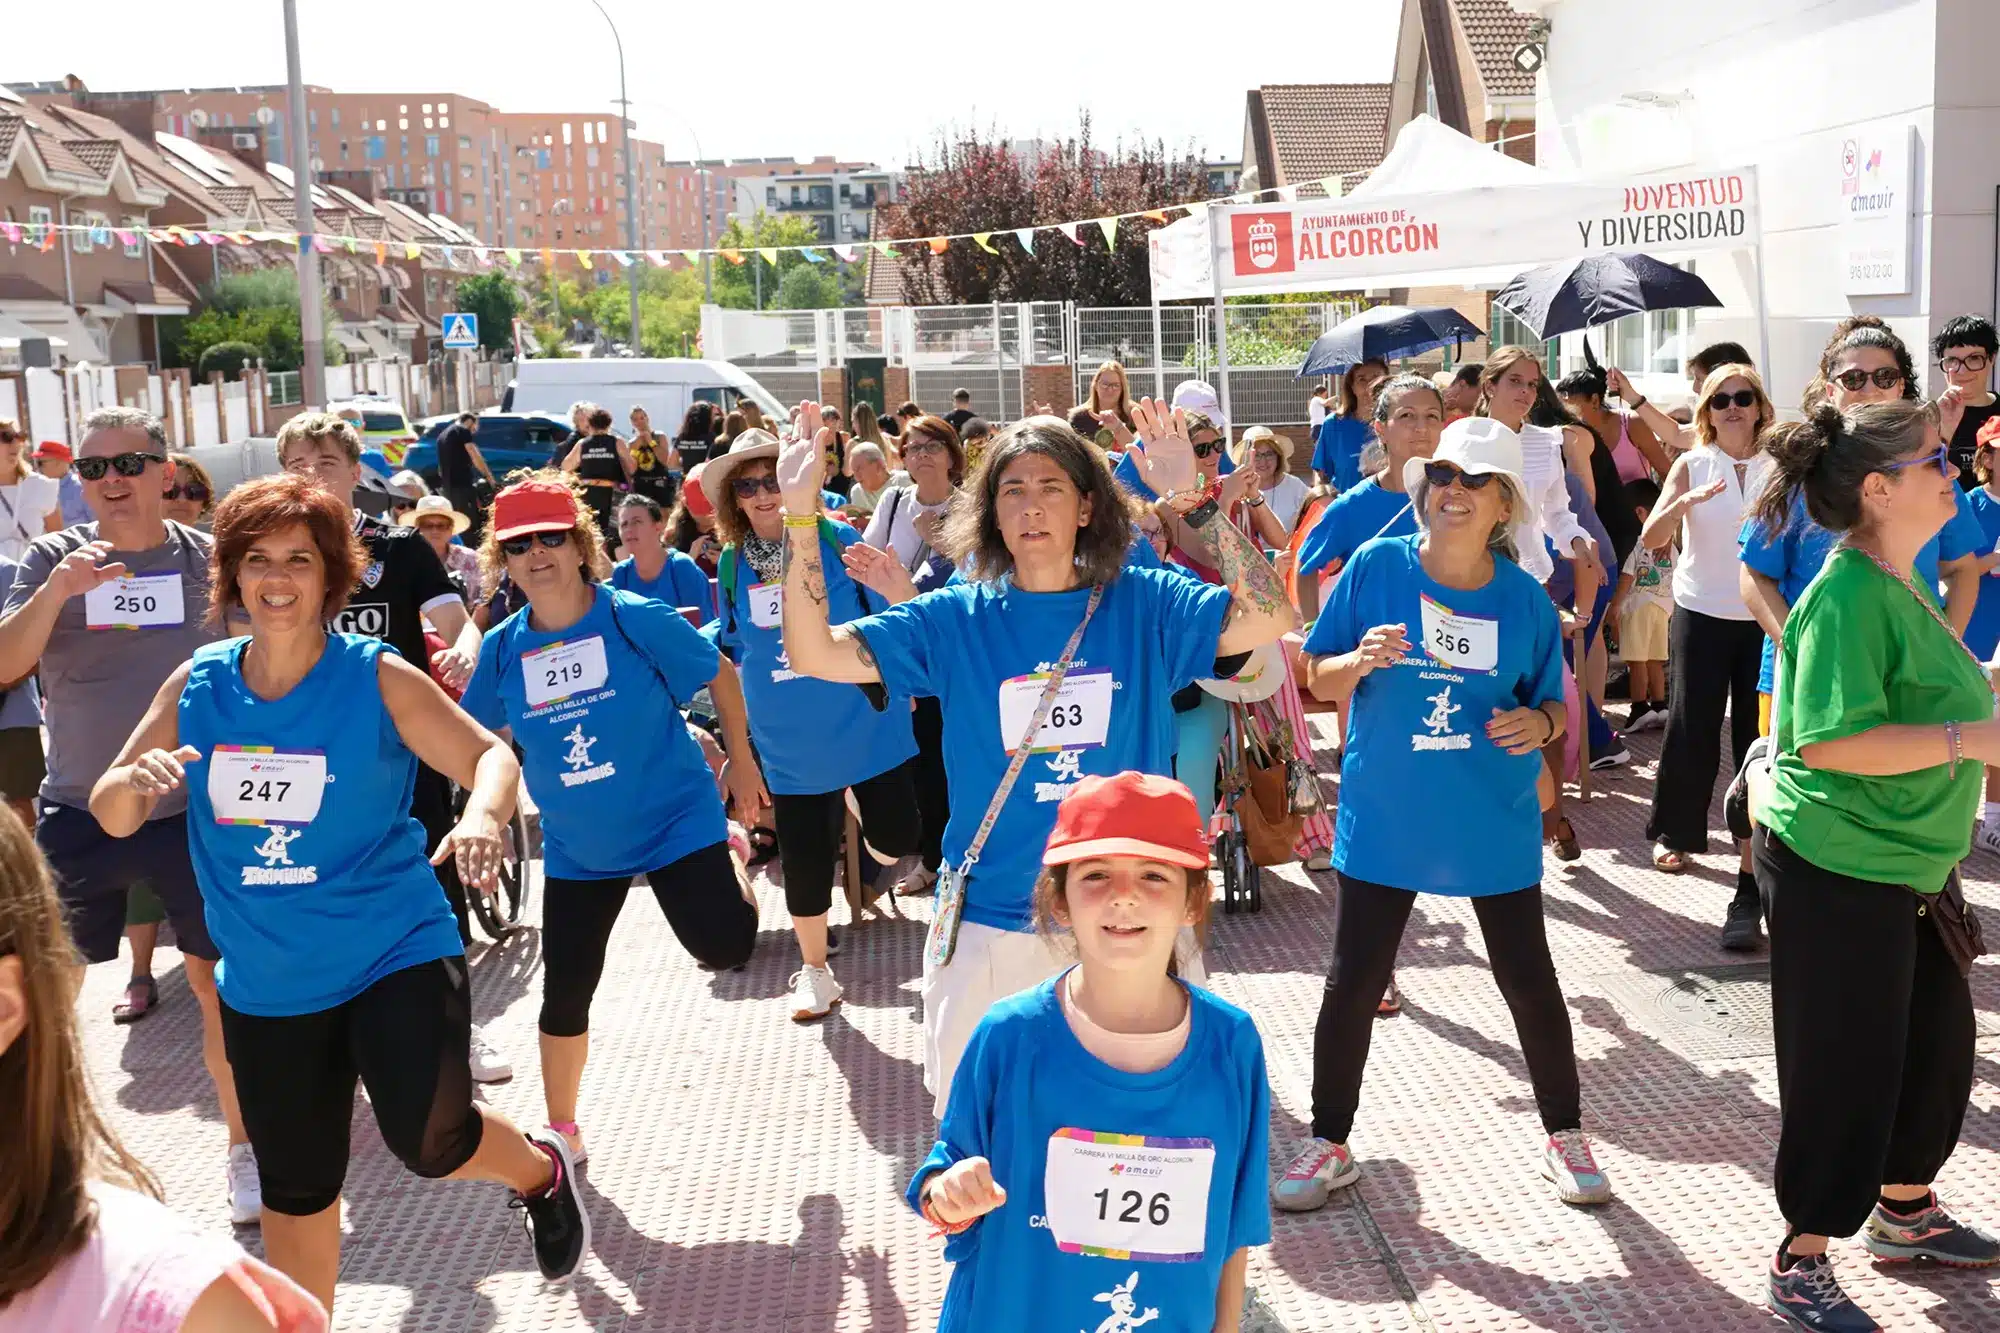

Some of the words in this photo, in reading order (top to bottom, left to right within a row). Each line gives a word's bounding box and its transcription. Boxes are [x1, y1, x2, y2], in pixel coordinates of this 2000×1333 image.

[1623, 176, 1743, 212] JUVENTUD
[1851, 185, 1894, 212] amavir
[1302, 211, 1388, 230] AYUNTAMIENTO
[1392, 209, 1406, 223] DE
[1578, 220, 1592, 248] Y
[1602, 209, 1744, 246] DIVERSIDAD
[1299, 216, 1438, 261] ALCORCÓN
[114, 595, 156, 613] 250
[1436, 628, 1470, 655] 256
[546, 663, 582, 687] 219
[1419, 671, 1464, 683] ALCORCÓN
[522, 706, 554, 719] CARRERA
[555, 703, 562, 711] VI
[563, 698, 587, 709] MILLA
[587, 695, 598, 703] DE
[599, 689, 616, 700] ORO
[549, 708, 589, 724] ALCORCÓN
[1034, 704, 1082, 728] 63
[239, 780, 292, 802] 247
[1074, 1148, 1105, 1159] CARRERA
[1147, 1155, 1161, 1163] ORO
[1126, 1166, 1163, 1175] amavir
[1094, 1188, 1171, 1226] 126
